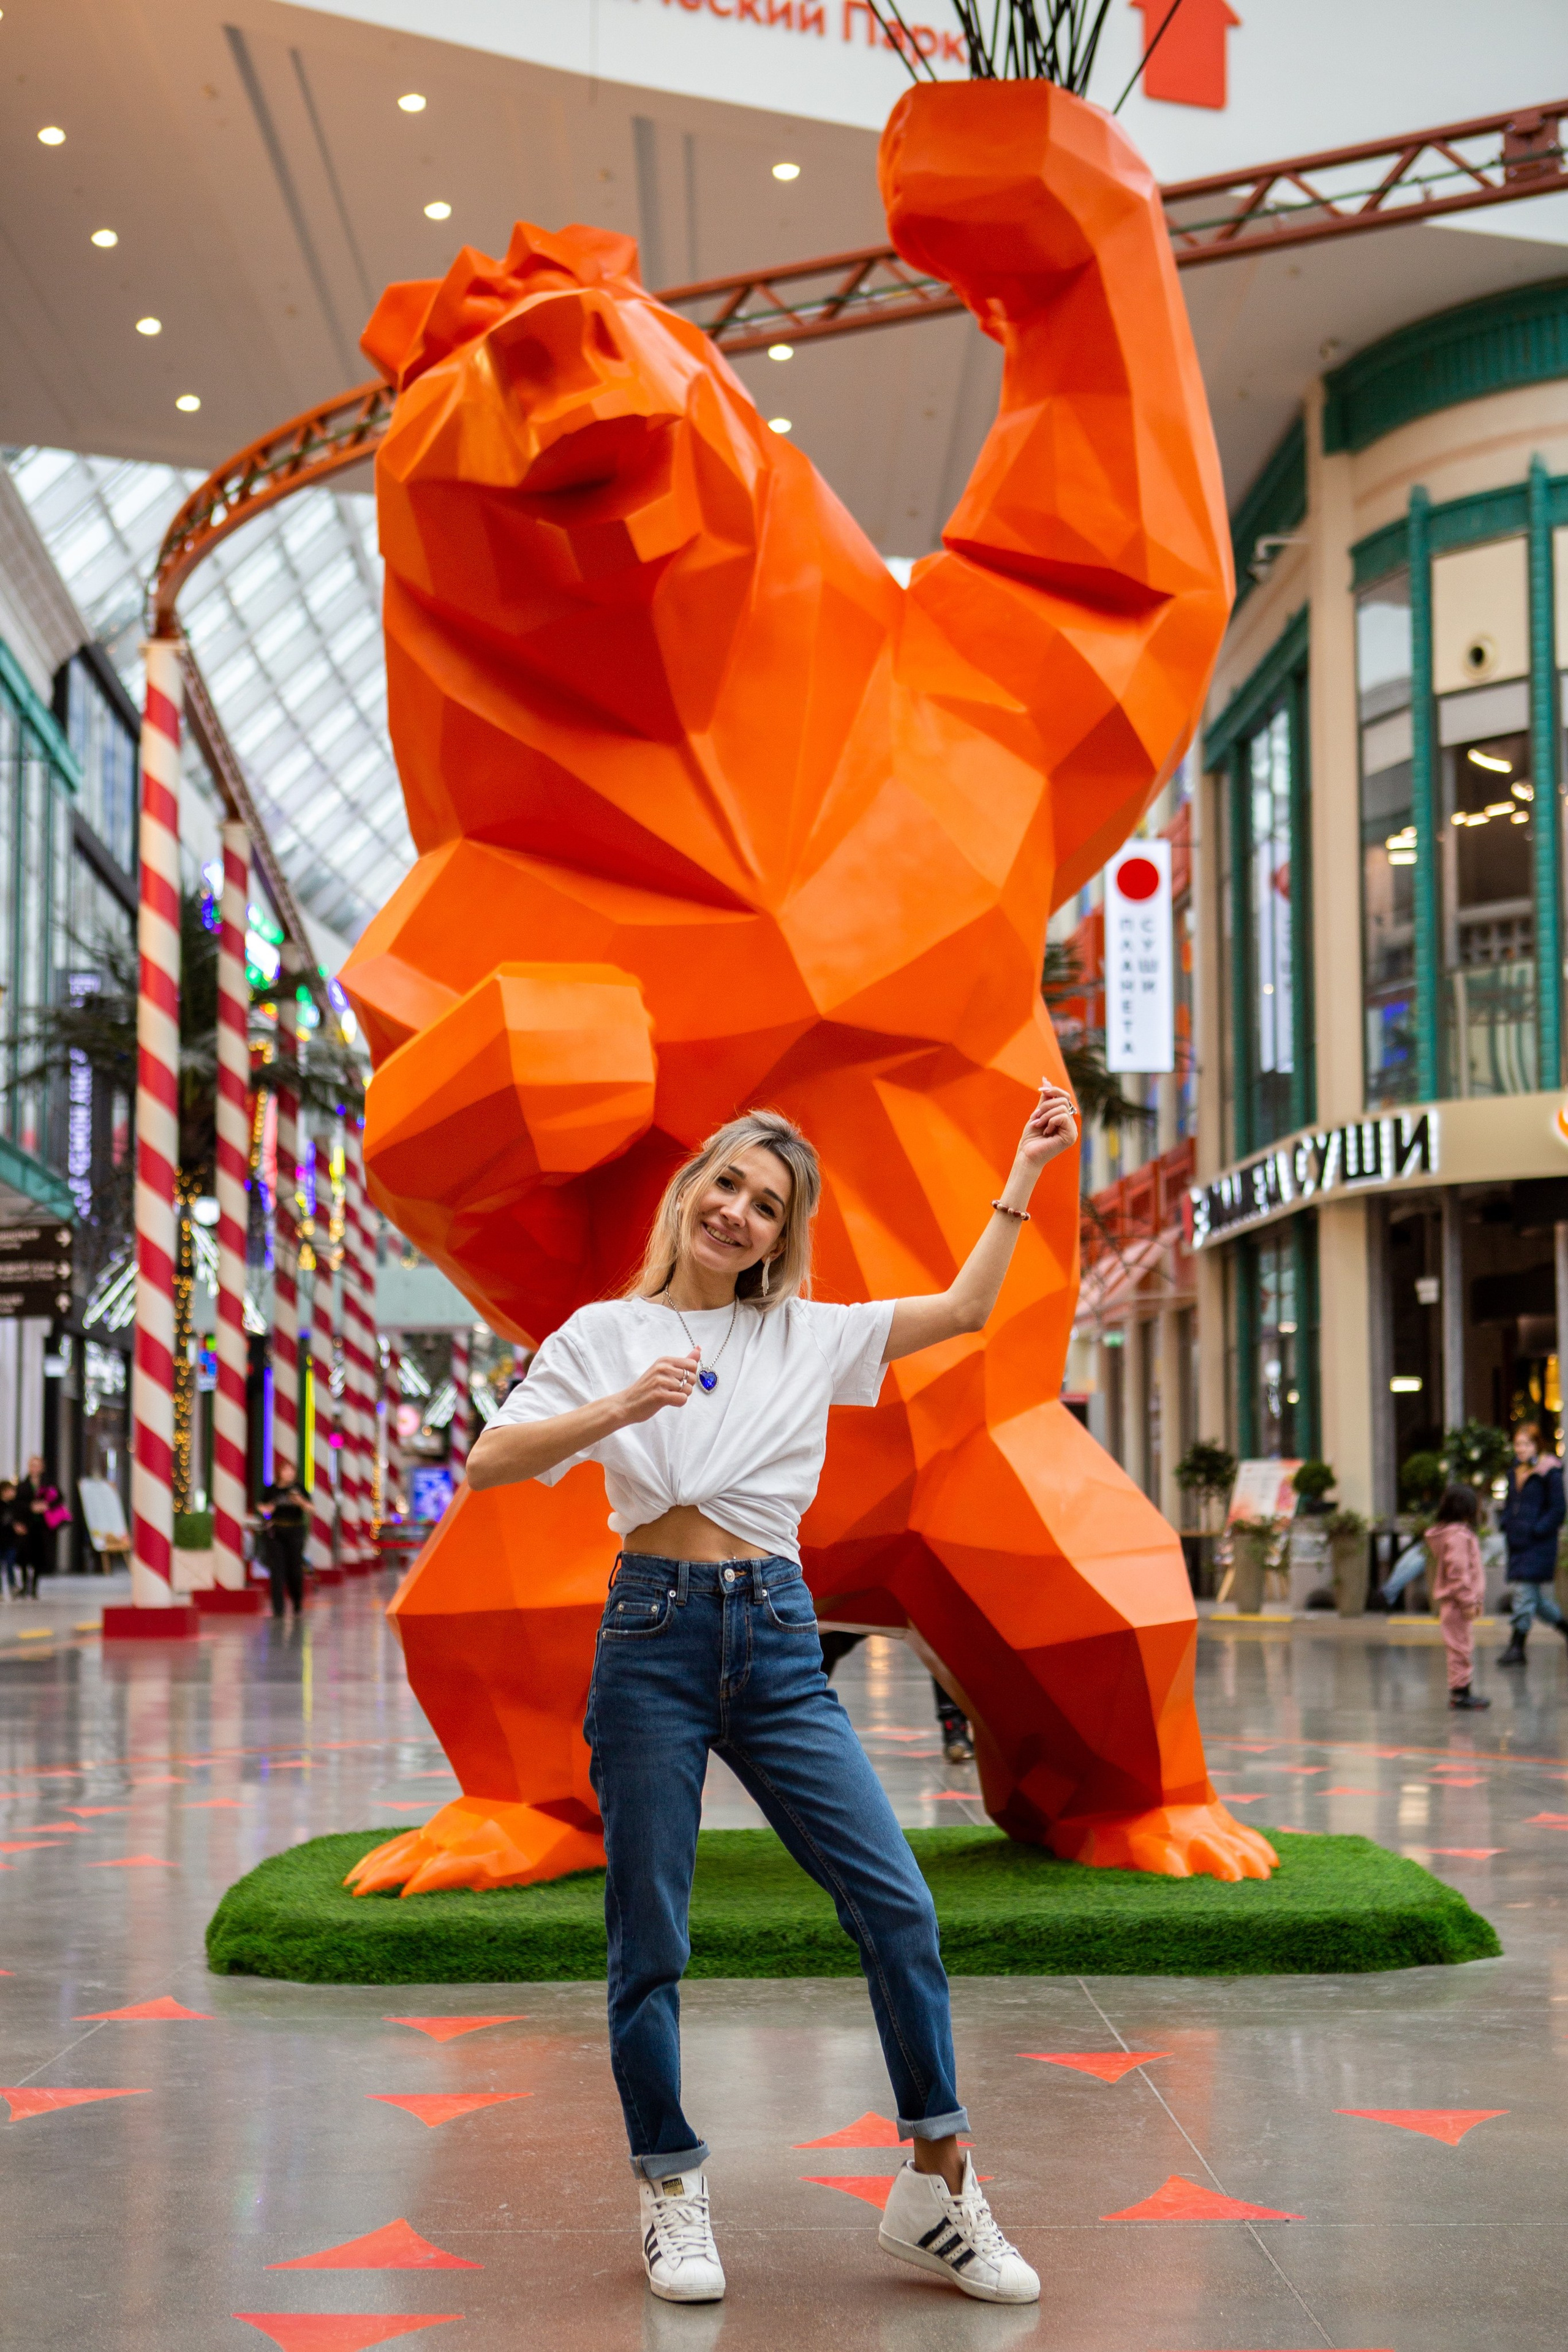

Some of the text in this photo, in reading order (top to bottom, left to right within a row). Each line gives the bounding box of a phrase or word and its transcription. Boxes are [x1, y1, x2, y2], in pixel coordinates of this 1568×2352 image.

[842, 1, 967, 66] Парк
[1139, 918, 1159, 993] СУШИ
[1294, 1109, 1439, 1199] СУШИ
